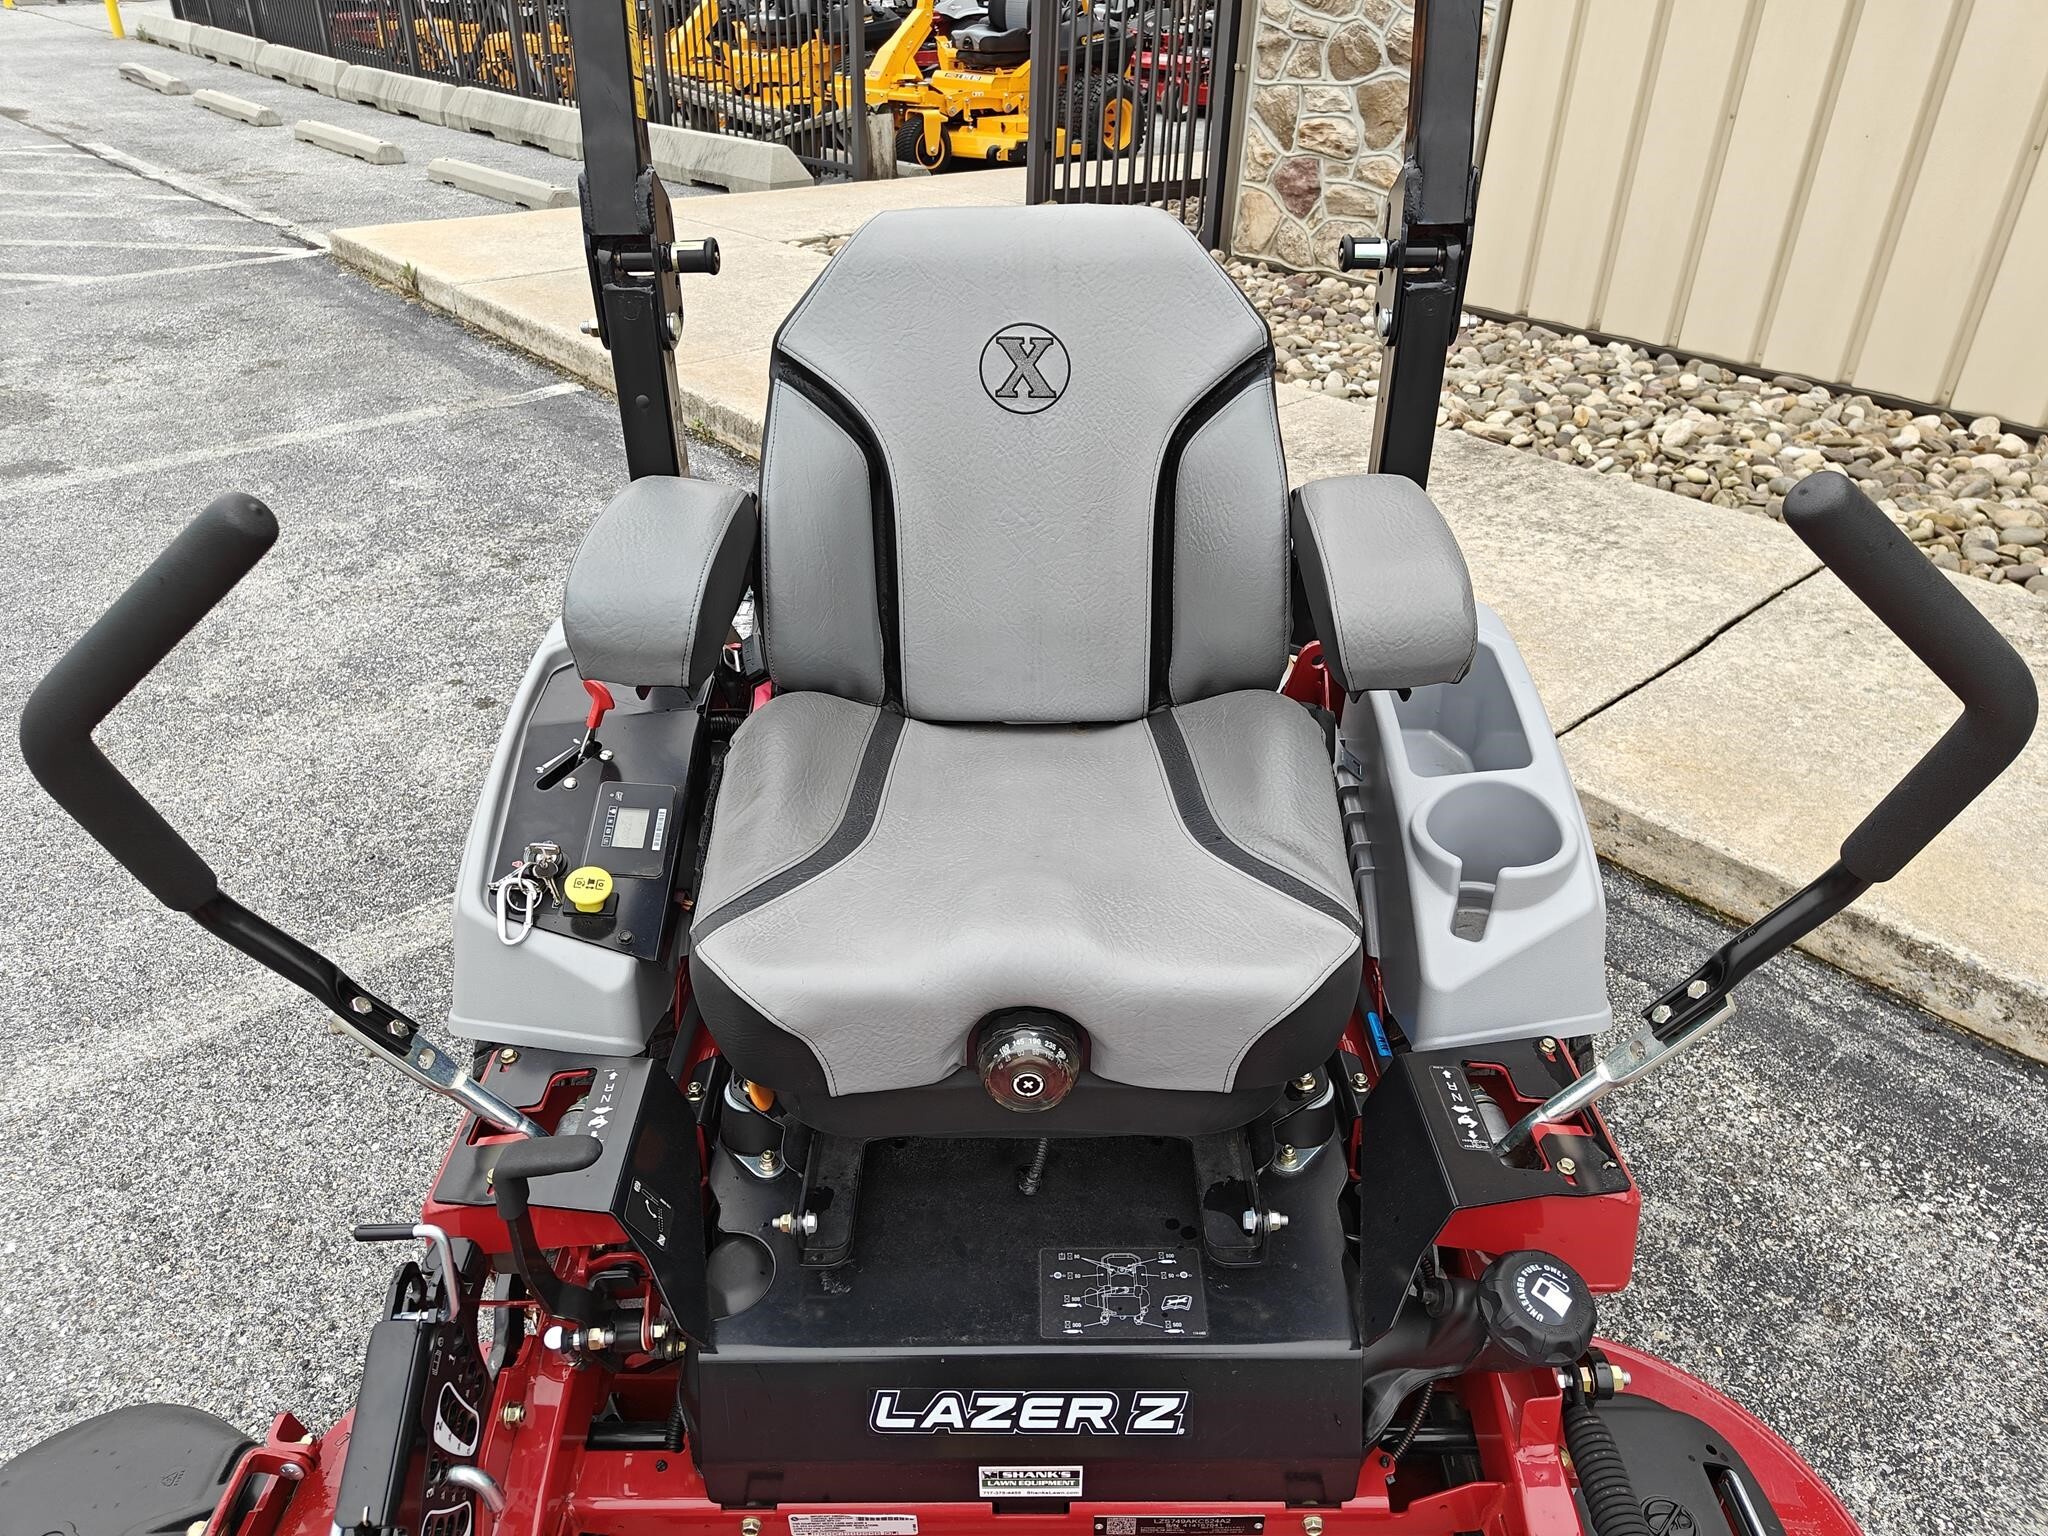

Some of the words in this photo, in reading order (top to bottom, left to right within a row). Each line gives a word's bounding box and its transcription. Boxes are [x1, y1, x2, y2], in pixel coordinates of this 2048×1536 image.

[996, 337, 1057, 398] X
[1521, 1264, 1543, 1277] FUEL
[1543, 1264, 1568, 1280] ONLY
[1516, 1276, 1545, 1323] UNLEADED
[870, 1391, 1118, 1434] LAZER
